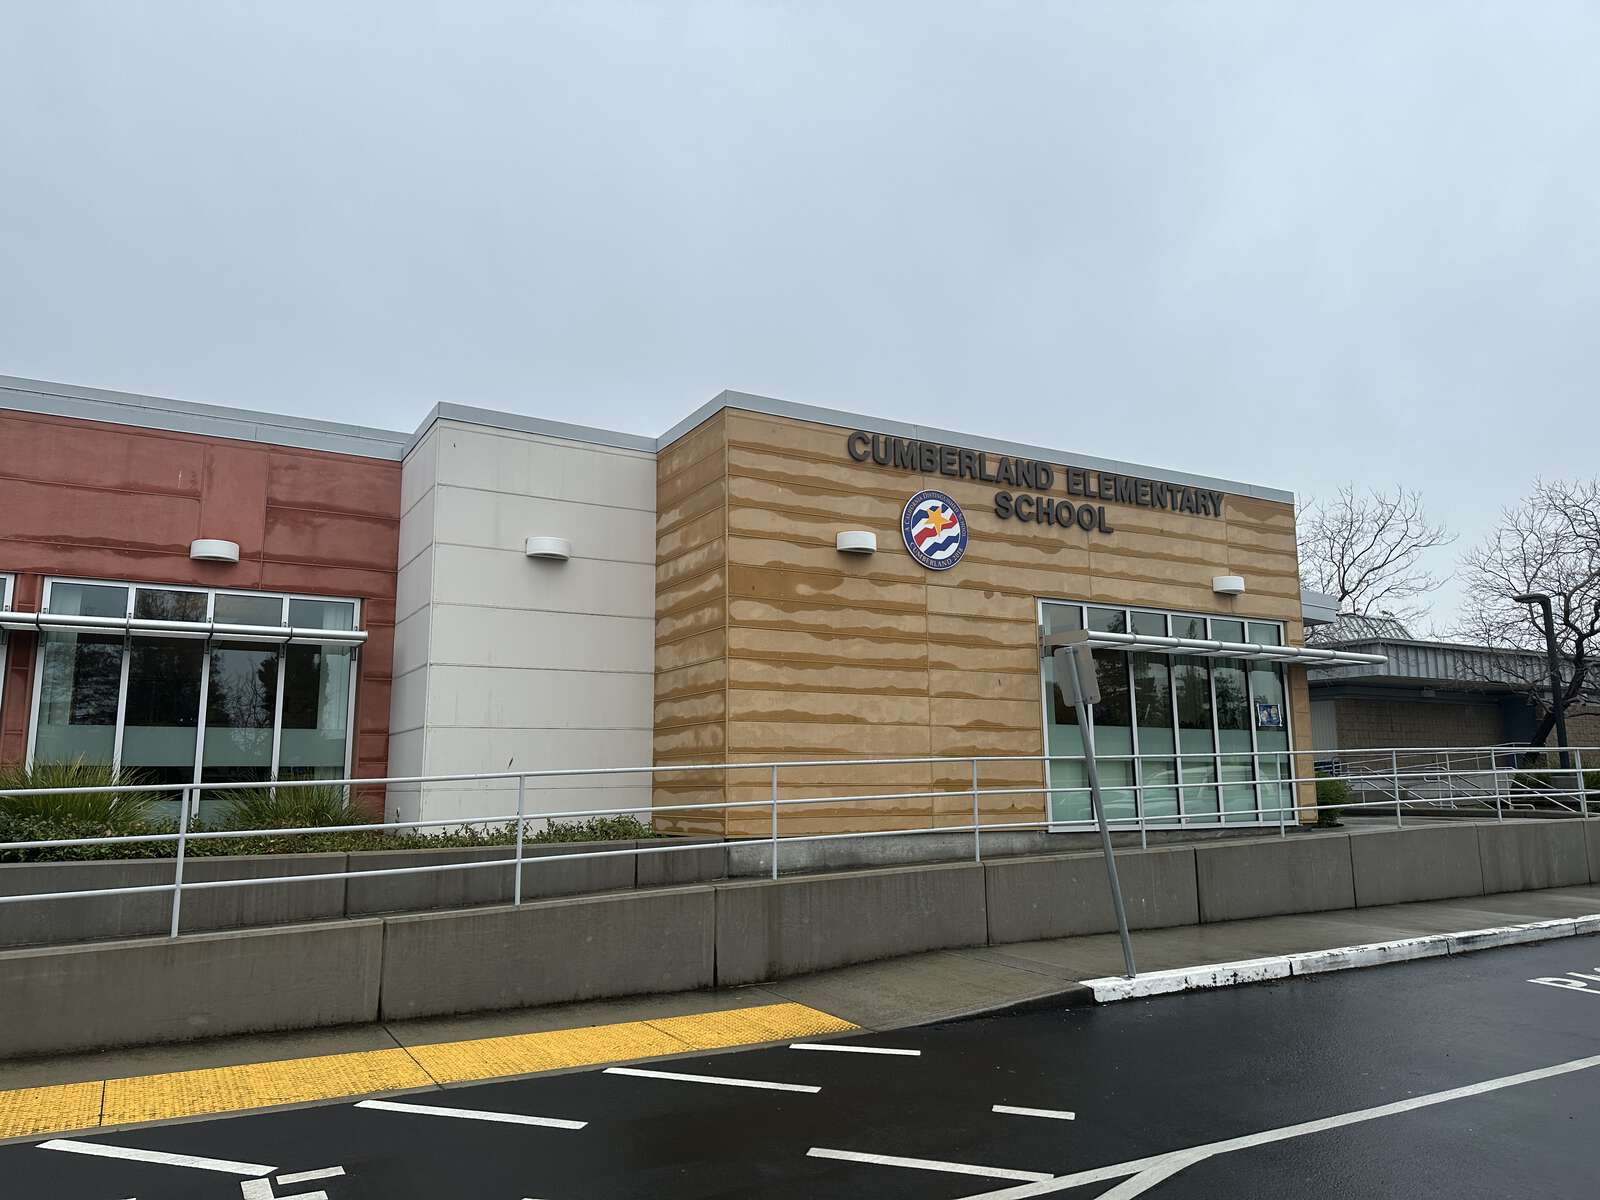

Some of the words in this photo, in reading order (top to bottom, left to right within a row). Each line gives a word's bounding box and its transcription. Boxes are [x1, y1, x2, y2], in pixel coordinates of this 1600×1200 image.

[848, 431, 1054, 490] CUMBERLAND
[1067, 467, 1224, 518] ELEMENTARY
[995, 490, 1114, 534] SCHOOL
[909, 542, 952, 567] CUMBERLAND
